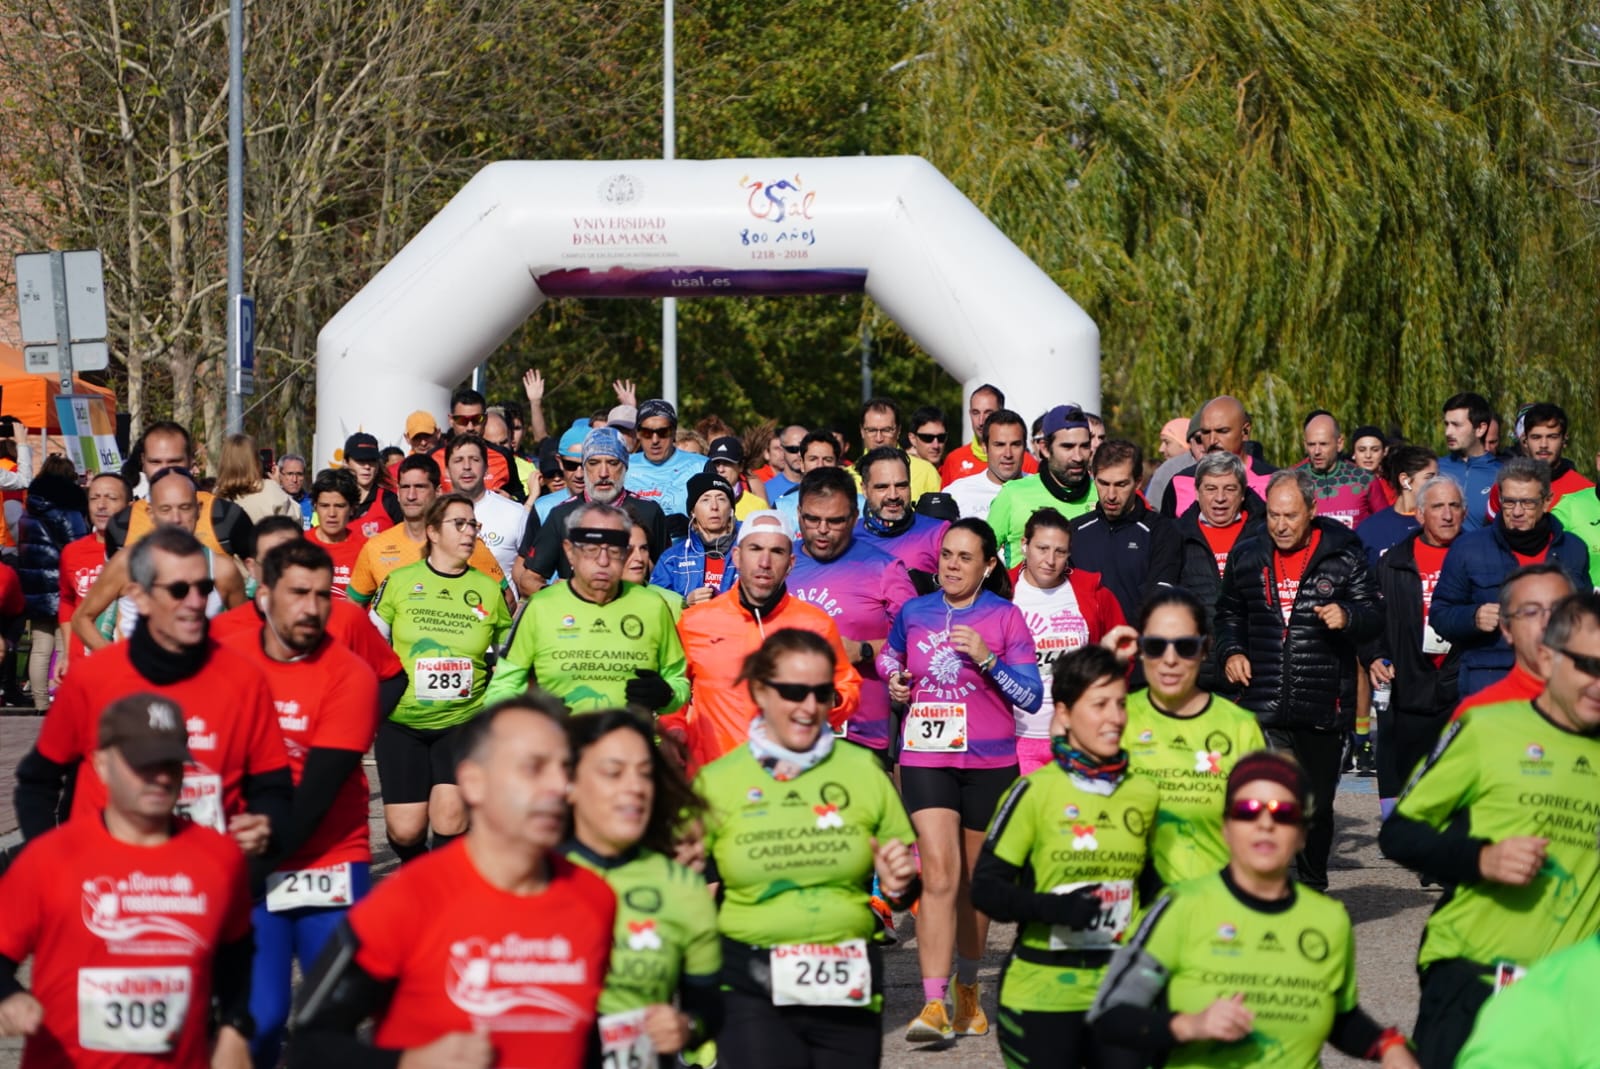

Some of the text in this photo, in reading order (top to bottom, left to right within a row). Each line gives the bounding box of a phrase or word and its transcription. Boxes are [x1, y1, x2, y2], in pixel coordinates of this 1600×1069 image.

[740, 228, 815, 246] 800 AÑOS
[751, 250, 775, 259] 1218
[784, 250, 808, 259] 2018
[671, 275, 731, 288] usal.es
[242, 304, 252, 361] P
[789, 587, 843, 617] aches
[413, 616, 472, 629] CARBAJOSA
[419, 625, 464, 635] SALAMANCA
[1037, 636, 1078, 649] dunia
[551, 649, 649, 661] CORRECAMINOS
[560, 662, 638, 673] CARBAJOSA
[428, 673, 462, 689] 283
[571, 674, 626, 682] SALAMANCA
[921, 720, 946, 738] 37
[1157, 781, 1223, 793] RBAJOSA
[748, 840, 850, 859] CARBAJOSA
[763, 858, 837, 871] SALAMANCA
[285, 873, 331, 893] 210
[796, 961, 849, 985] 265
[105, 1000, 167, 1028] 308
